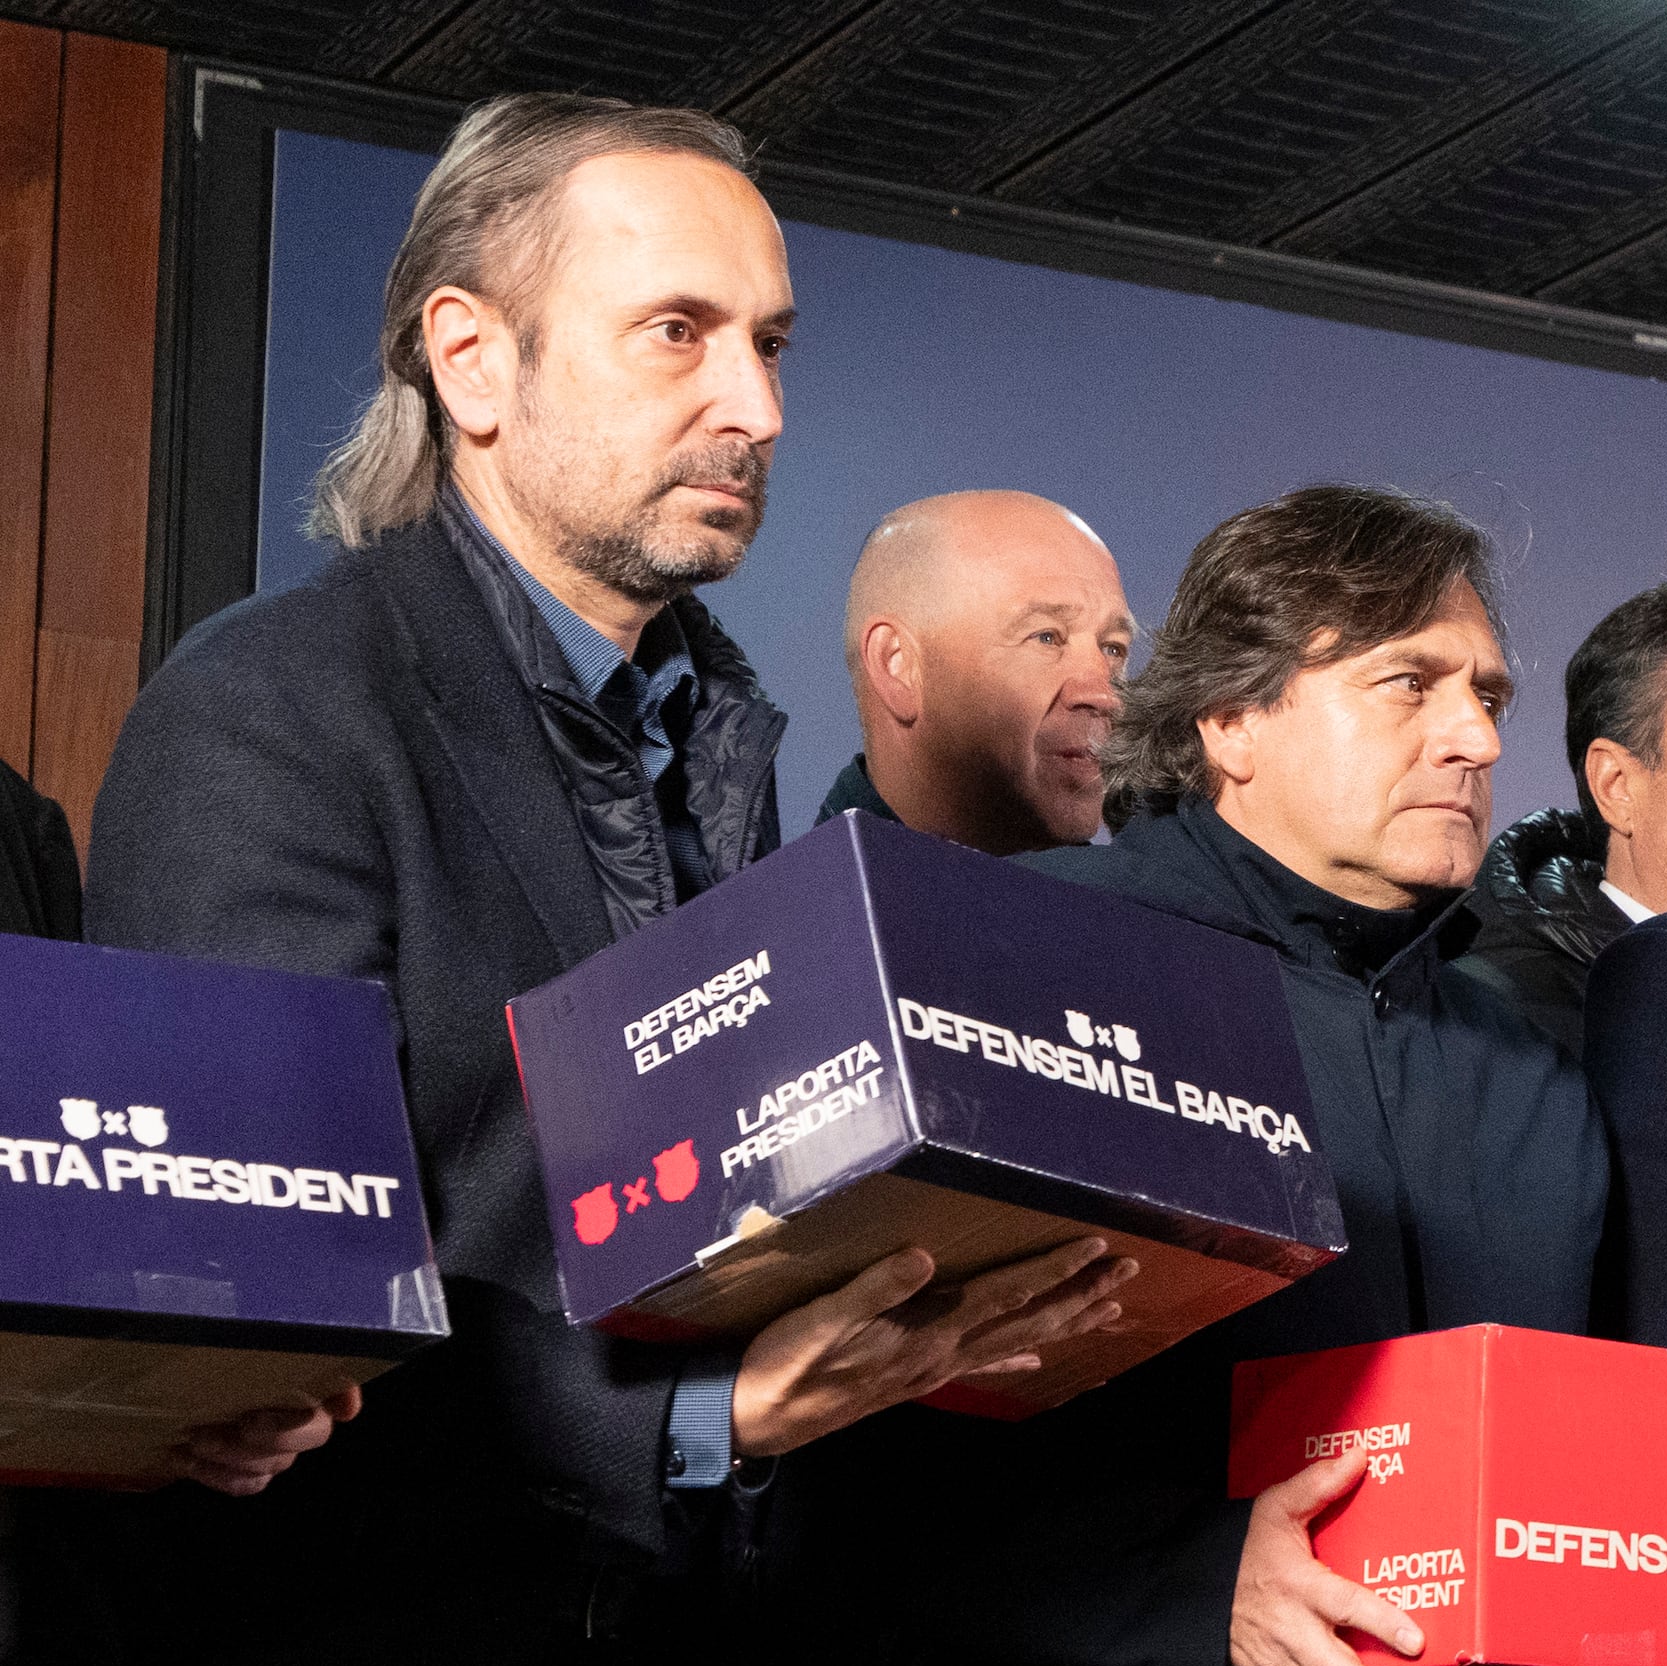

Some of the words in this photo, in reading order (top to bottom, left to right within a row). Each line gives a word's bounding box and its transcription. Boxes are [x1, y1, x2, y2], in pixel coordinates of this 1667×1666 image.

[623, 950, 771, 1050] DEFENSEM
[633, 1041, 673, 1075] EL
[671, 985, 771, 1055] BARÇA
[720, 1066, 884, 1178] PRESIDENT
[736, 1040, 881, 1136] LAPORTA
[897, 997, 1121, 1098] DEFENSEM
[1122, 1064, 1176, 1114] EL
[1178, 1083, 1312, 1157] BARÇA
[102, 1147, 399, 1218] PRESIDENT
[1305, 1423, 1410, 1459] DEFENSEM
[1367, 1452, 1404, 1484] RÇA
[1364, 1548, 1465, 1584] LAPORTA
